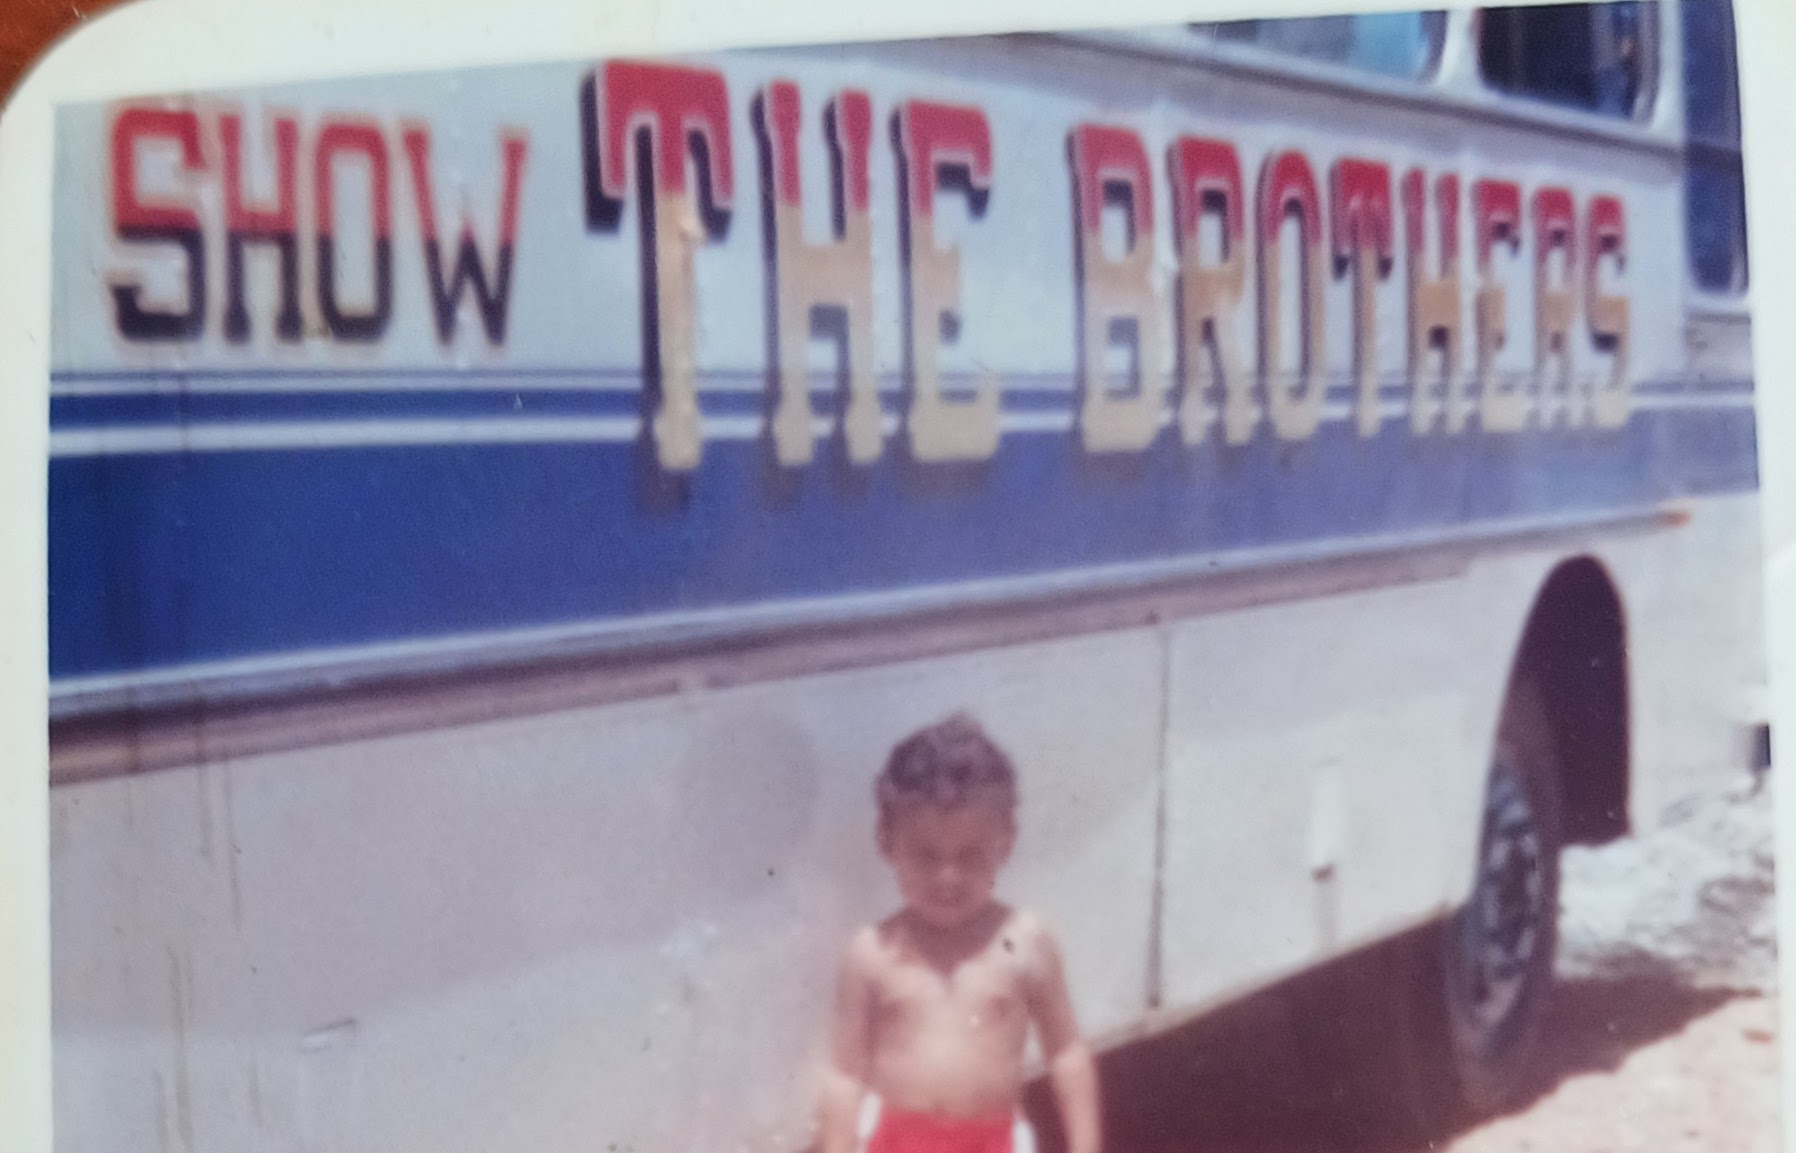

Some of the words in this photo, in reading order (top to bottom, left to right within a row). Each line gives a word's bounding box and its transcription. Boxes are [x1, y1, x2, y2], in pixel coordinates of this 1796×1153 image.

[108, 103, 528, 348] SHOW
[583, 60, 1001, 472] THE
[1069, 123, 1633, 454] BROTHERS
